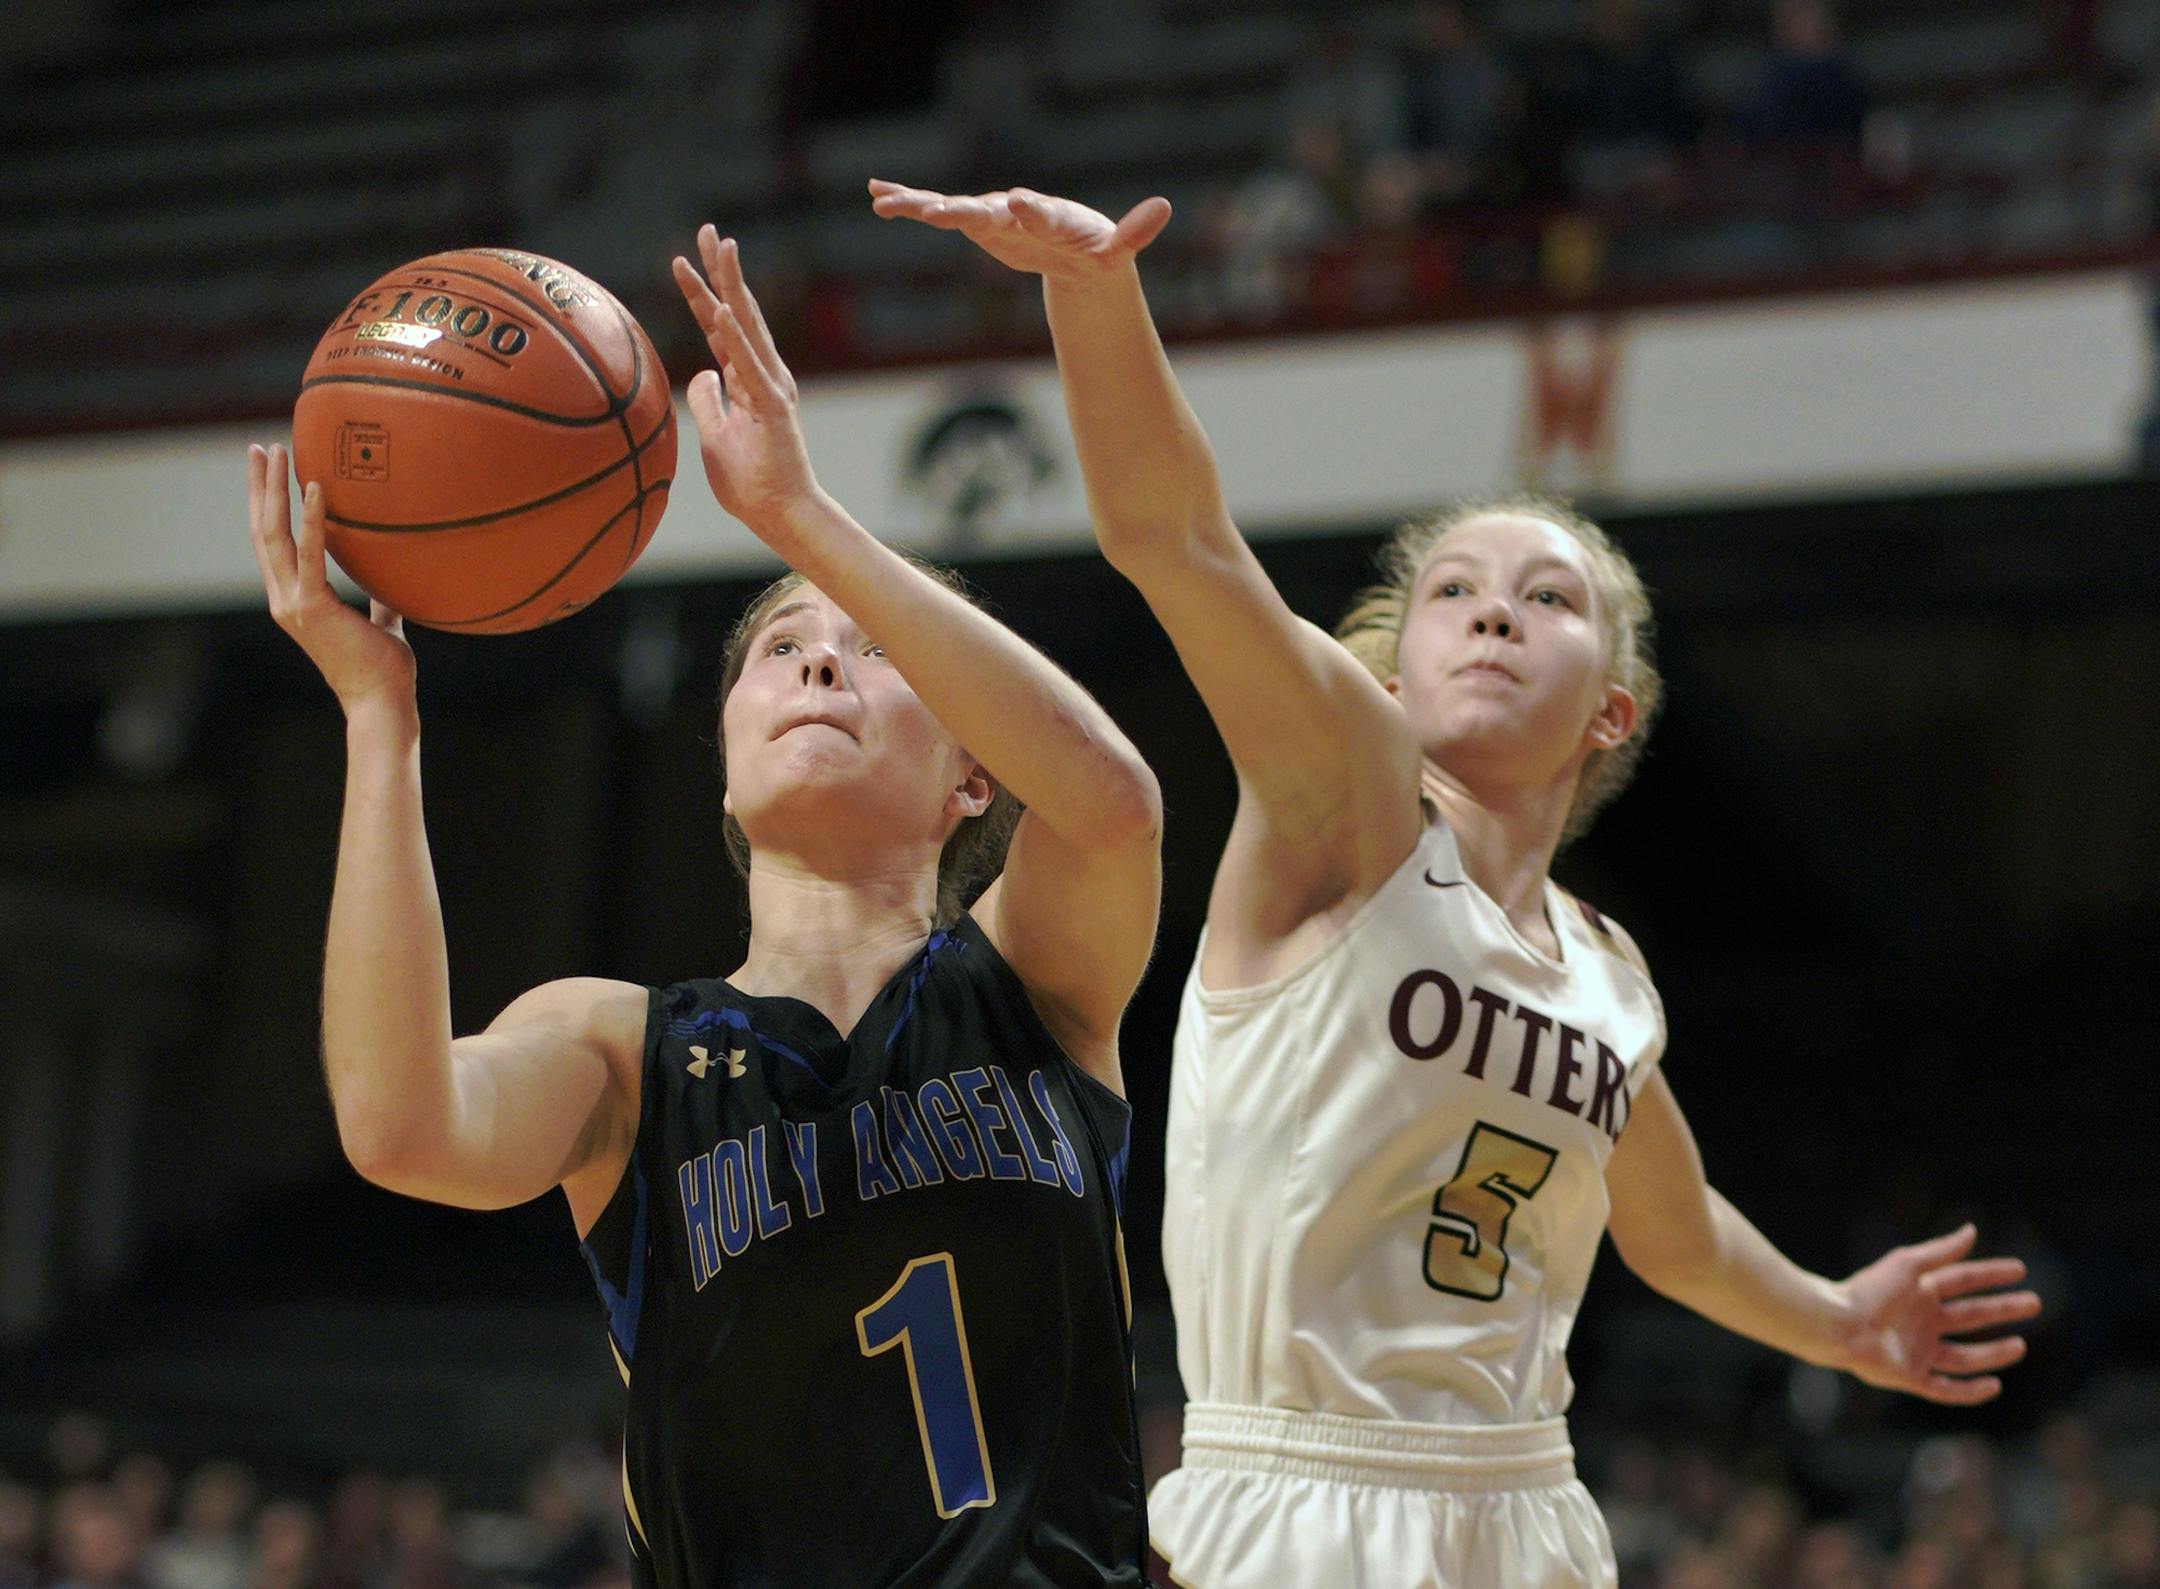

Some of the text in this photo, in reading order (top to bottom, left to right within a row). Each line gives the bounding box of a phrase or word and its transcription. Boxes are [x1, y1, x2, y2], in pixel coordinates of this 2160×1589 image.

[678, 1065, 1085, 1293] HOLY ANGELS
[1422, 1119, 1559, 1302] 5
[855, 1251, 997, 1519] 1
